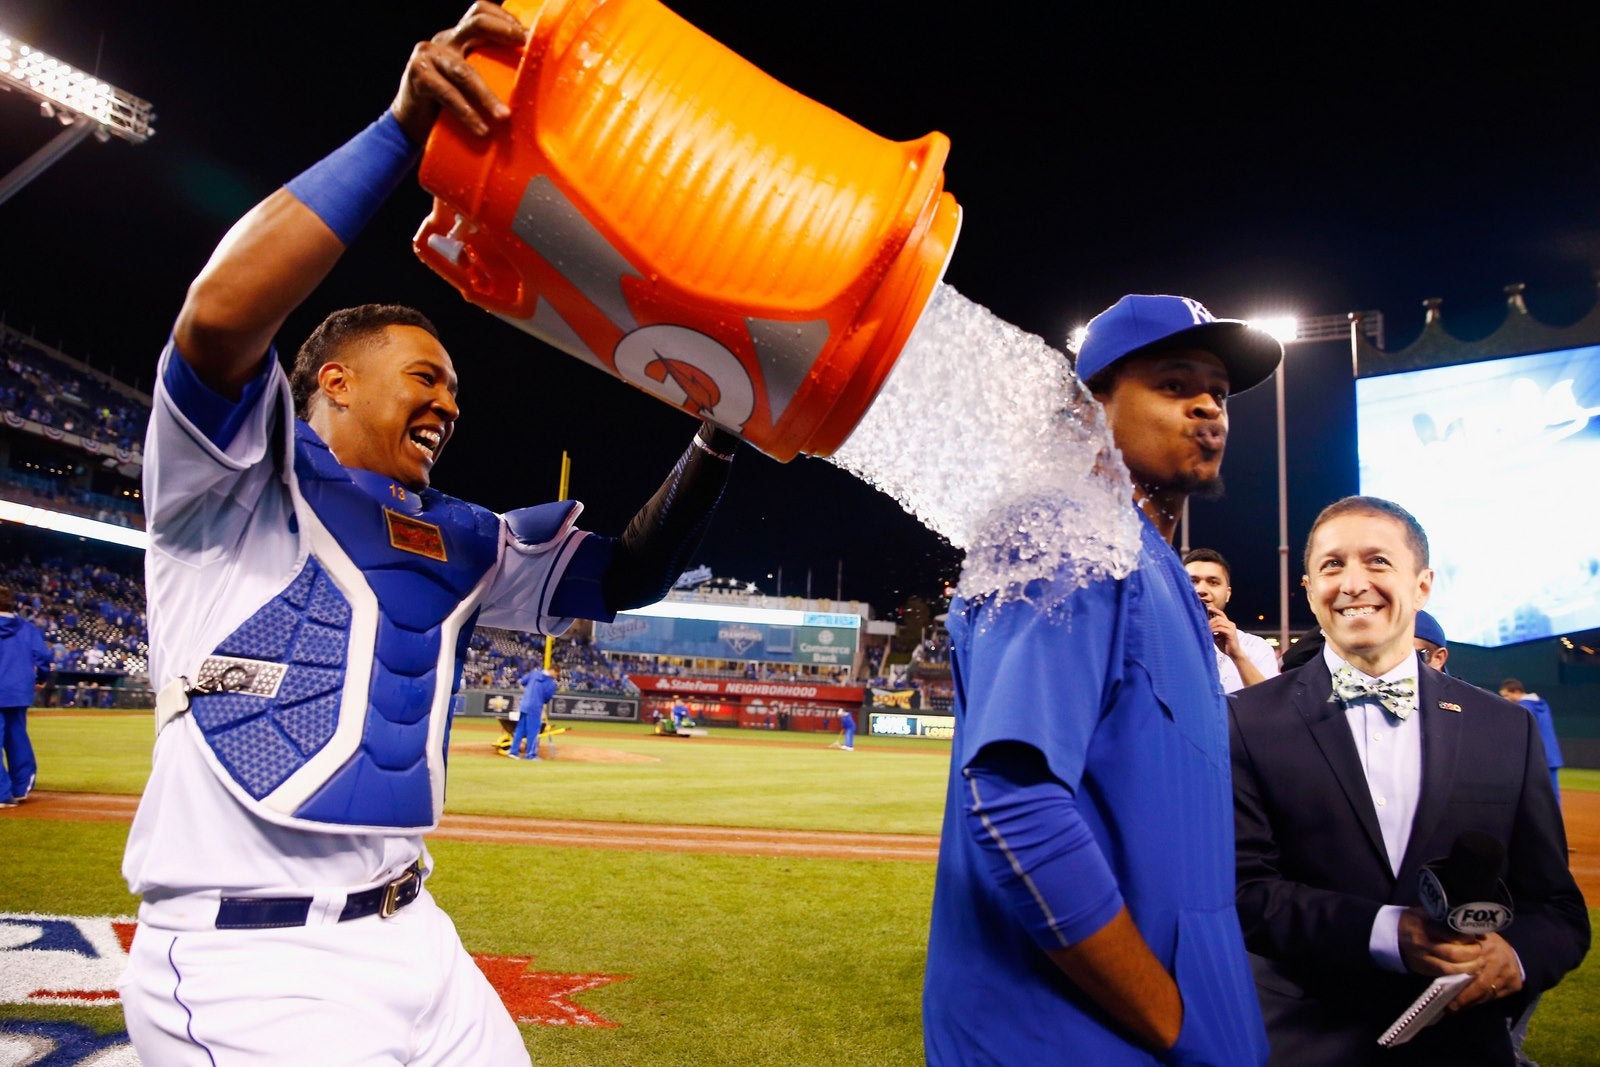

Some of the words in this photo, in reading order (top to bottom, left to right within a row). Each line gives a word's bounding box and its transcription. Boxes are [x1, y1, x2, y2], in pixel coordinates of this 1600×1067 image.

[389, 483, 407, 501] 13
[799, 642, 850, 655] Commerce
[812, 652, 838, 663] Bank
[724, 682, 818, 698] NEIGHBORHOOD
[873, 694, 910, 704] SONIC
[1462, 909, 1500, 923] FOX
[1460, 920, 1498, 928] SPORTS
